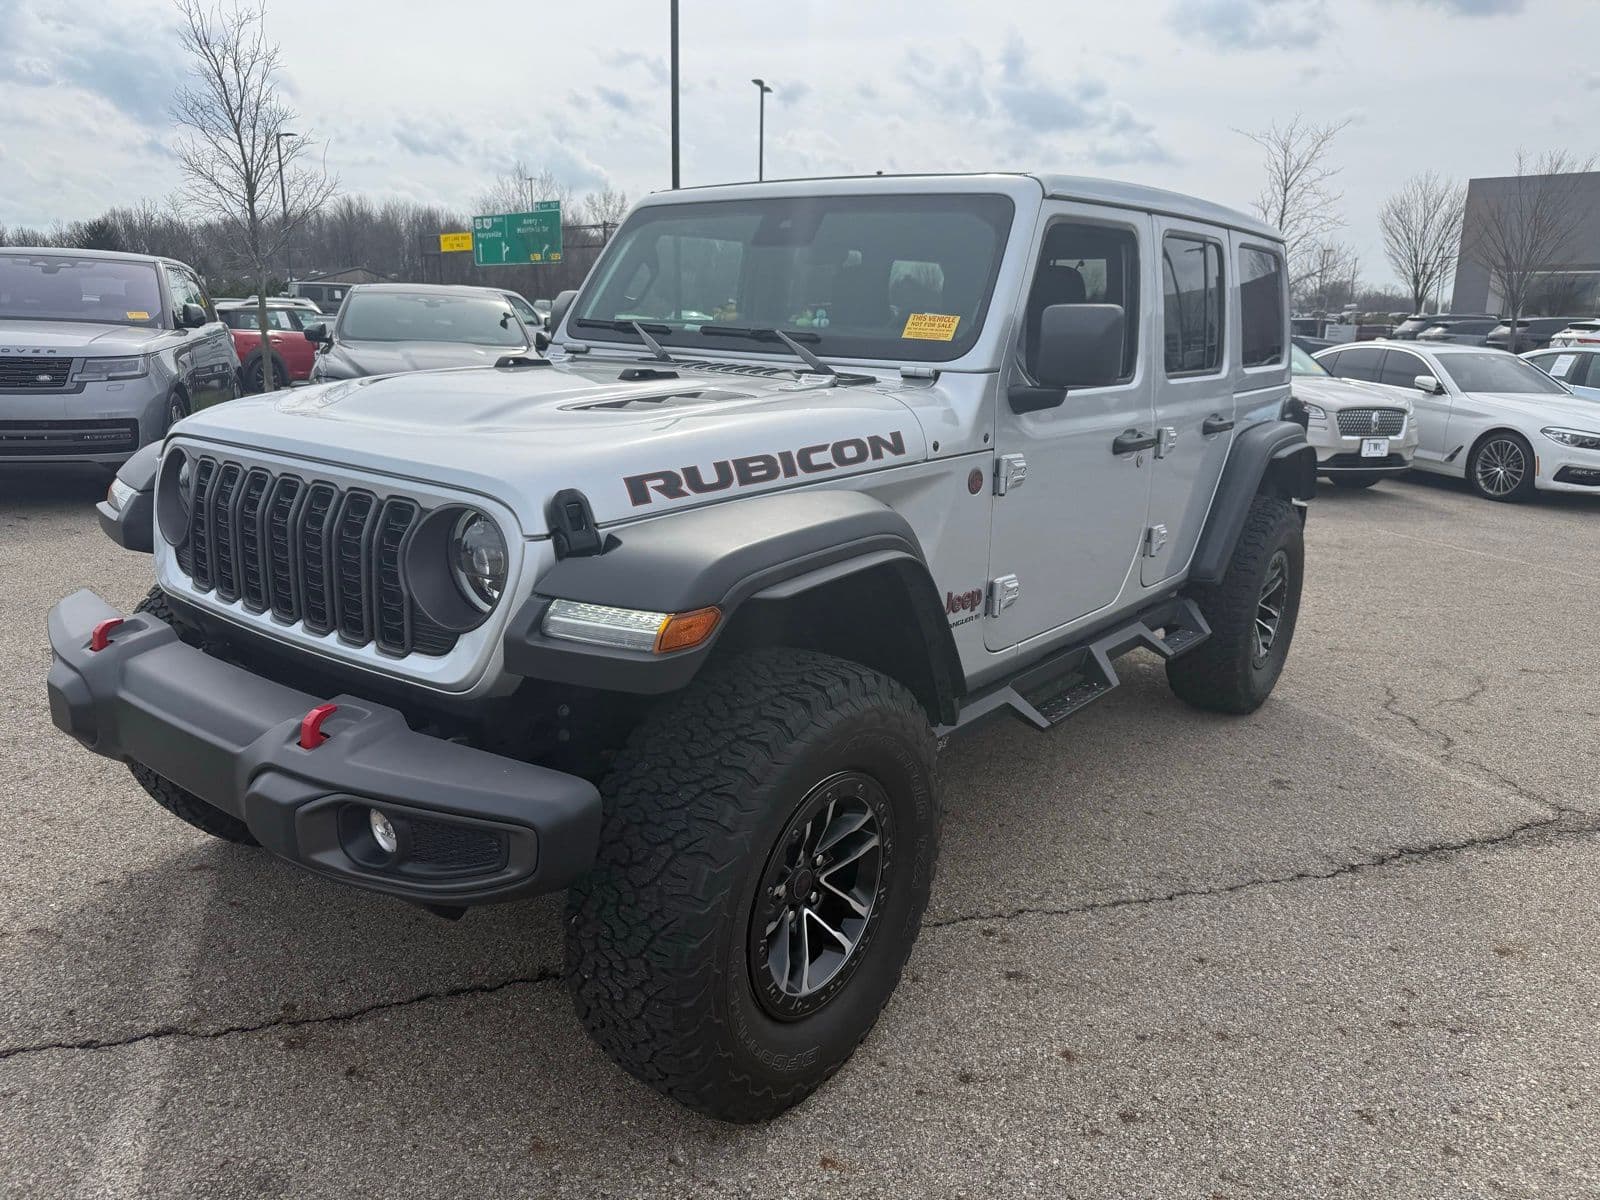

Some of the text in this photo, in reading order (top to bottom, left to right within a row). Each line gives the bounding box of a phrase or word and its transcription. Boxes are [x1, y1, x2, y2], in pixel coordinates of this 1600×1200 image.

[912, 314, 957, 323] THIS VEHICLE
[623, 430, 906, 507] RUBICON
[946, 589, 982, 614] Jeep
